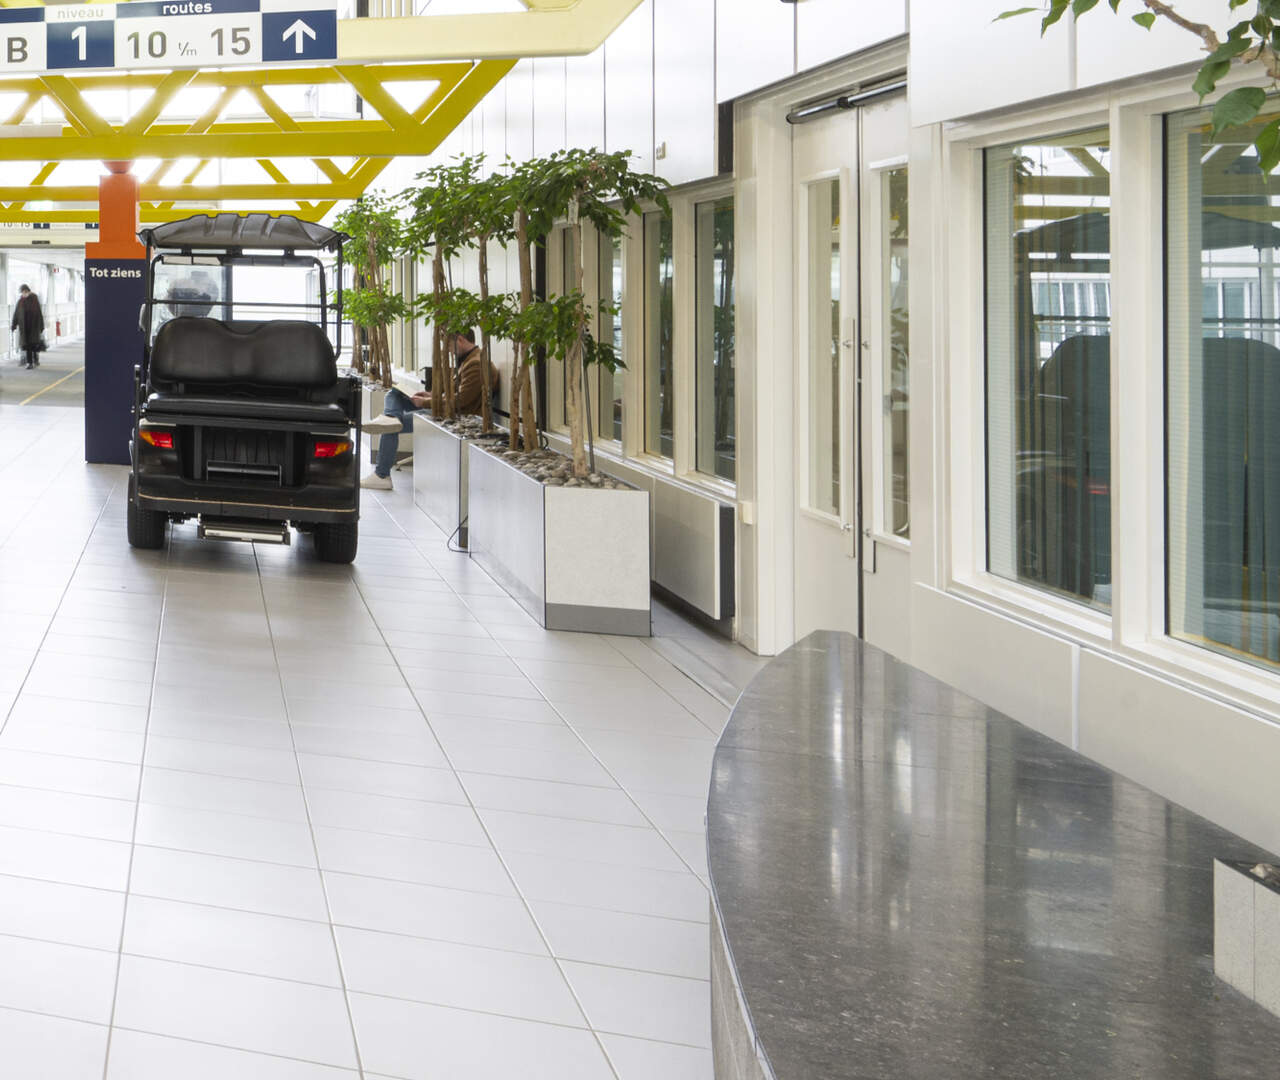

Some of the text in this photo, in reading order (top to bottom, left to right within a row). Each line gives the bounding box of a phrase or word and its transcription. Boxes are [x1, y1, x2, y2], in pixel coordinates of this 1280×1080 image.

[57, 5, 105, 20] niveau
[162, 1, 212, 15] routes
[7, 36, 28, 63] B
[71, 25, 87, 61] 1
[127, 31, 167, 59] 10
[210, 26, 252, 57] 15
[90, 267, 142, 278] Tot ziens
